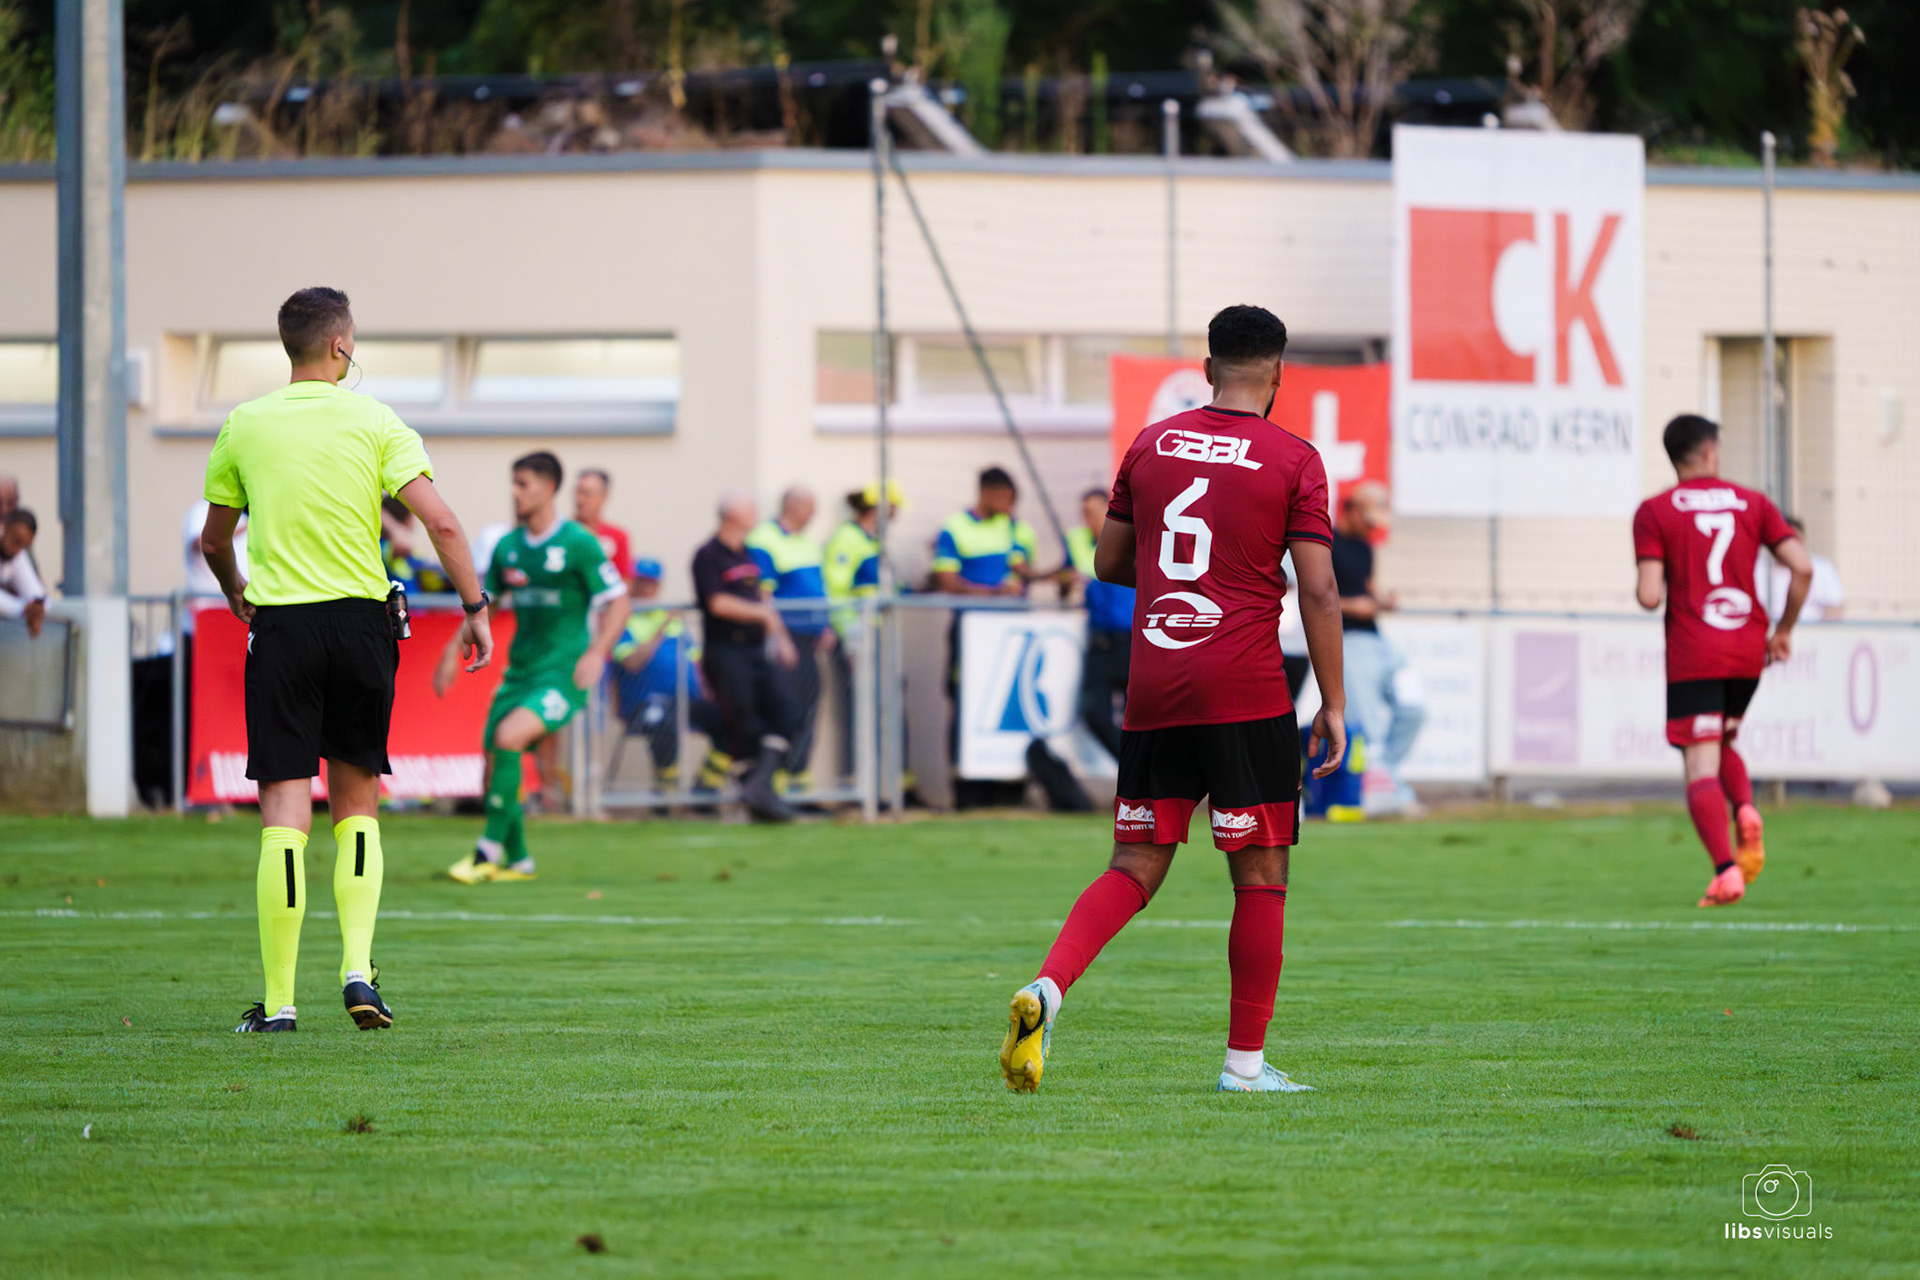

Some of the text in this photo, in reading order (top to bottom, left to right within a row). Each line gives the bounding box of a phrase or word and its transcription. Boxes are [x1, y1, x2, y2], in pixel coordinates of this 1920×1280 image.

[1155, 429, 1264, 471] GBBL
[1406, 402, 1634, 456] CONRAD KERN
[1158, 477, 1213, 581] 6
[1694, 511, 1736, 586] 7
[1145, 613, 1223, 628] TES
